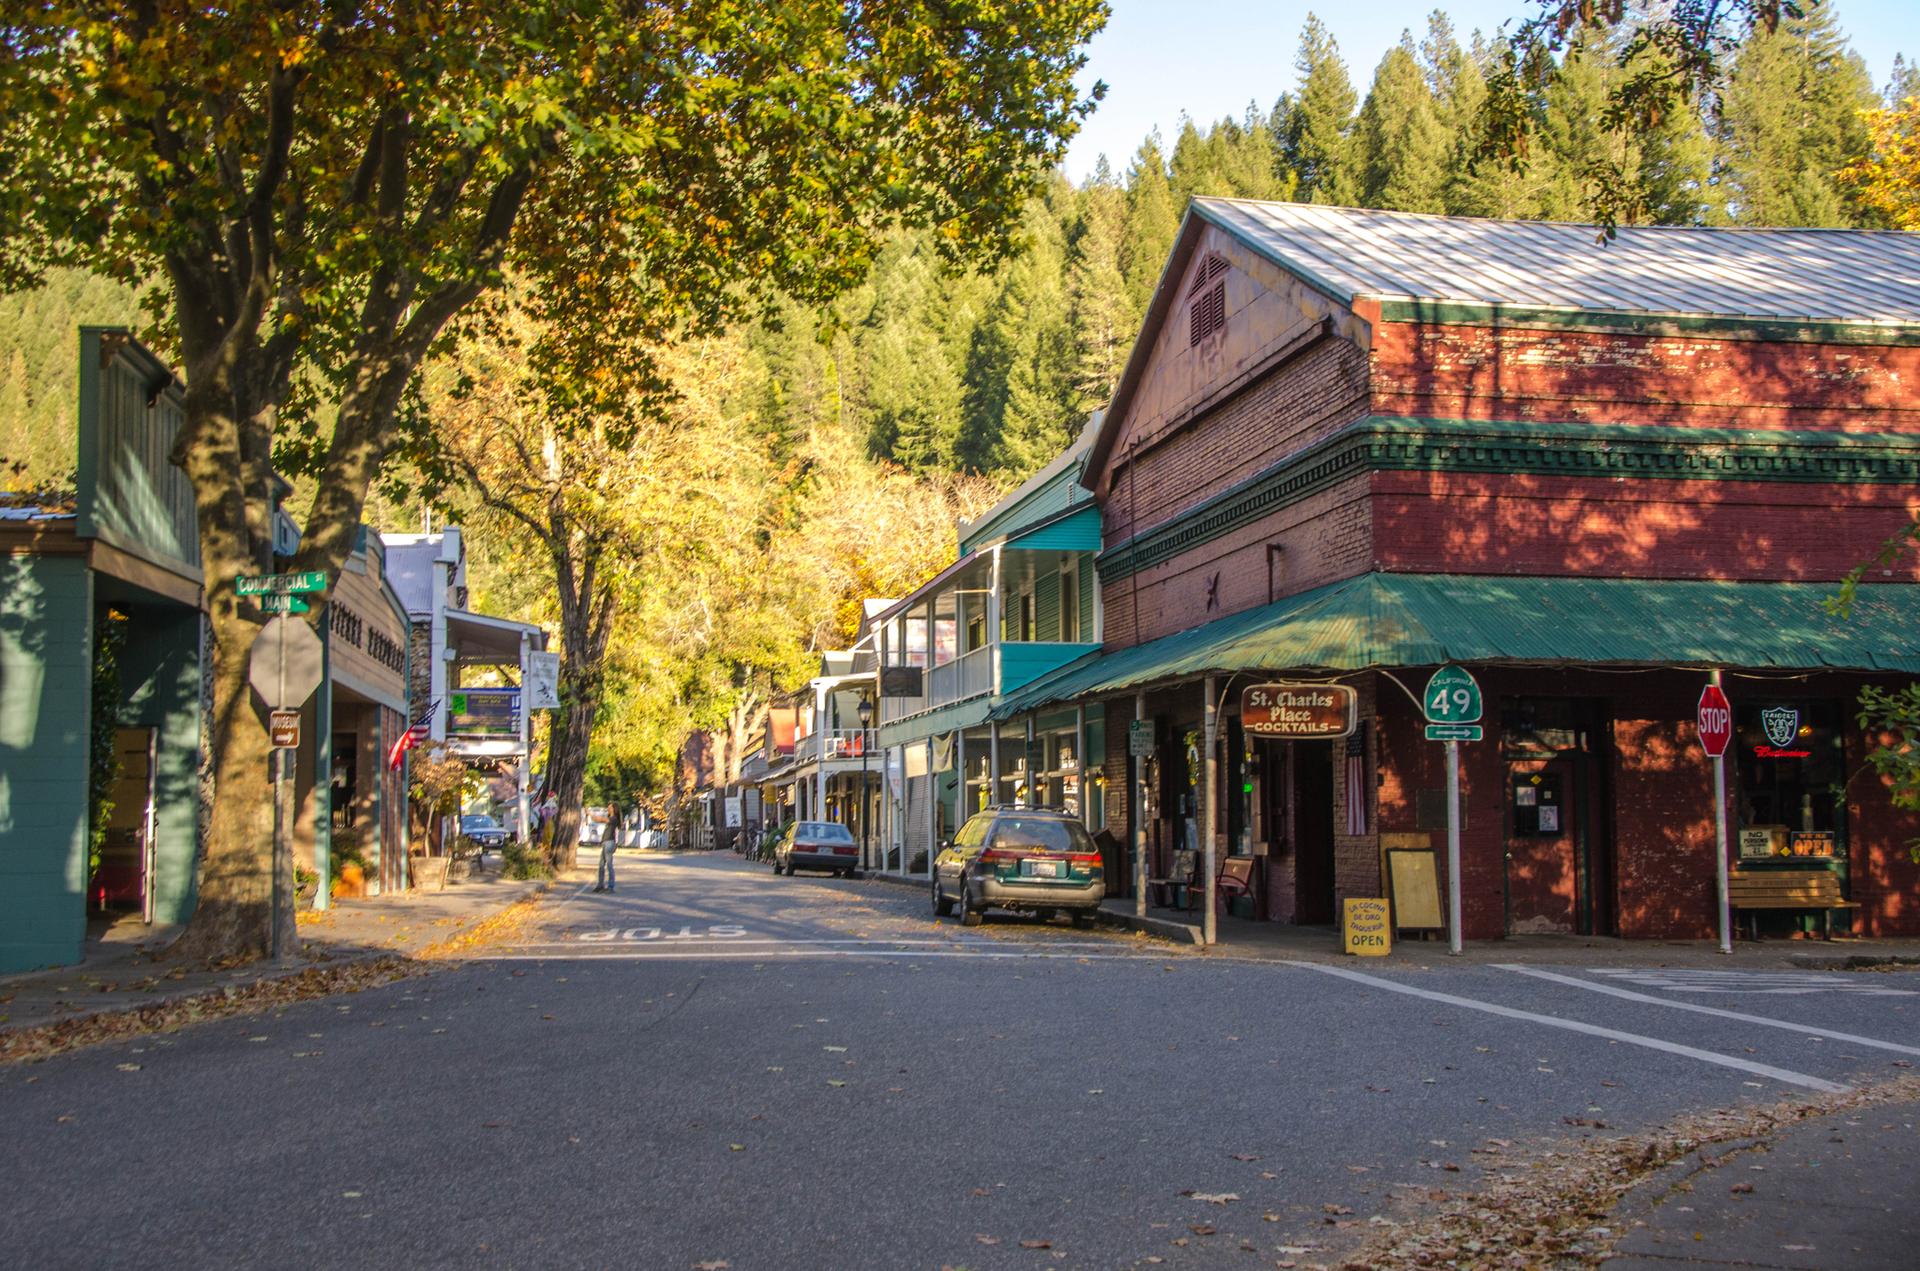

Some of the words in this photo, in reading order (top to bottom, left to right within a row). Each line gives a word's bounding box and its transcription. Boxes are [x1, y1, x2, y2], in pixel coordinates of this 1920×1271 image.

[240, 575, 310, 592] COMMERCIAL
[264, 594, 291, 611] MAIN
[1431, 677, 1473, 687] CALIFORNIA
[1250, 691, 1272, 706] St.
[1277, 691, 1334, 707] Charles
[1430, 688, 1471, 715] 49
[1270, 706, 1311, 722] Place
[1701, 707, 1728, 734] STOP
[1254, 722, 1329, 732] COCKTAILS
[1753, 746, 1811, 757] Budweiser
[1793, 839, 1833, 856] OPEN
[1359, 902, 1385, 913] COCINA
[579, 924, 747, 942] STOP
[1352, 935, 1384, 946] OPEN
